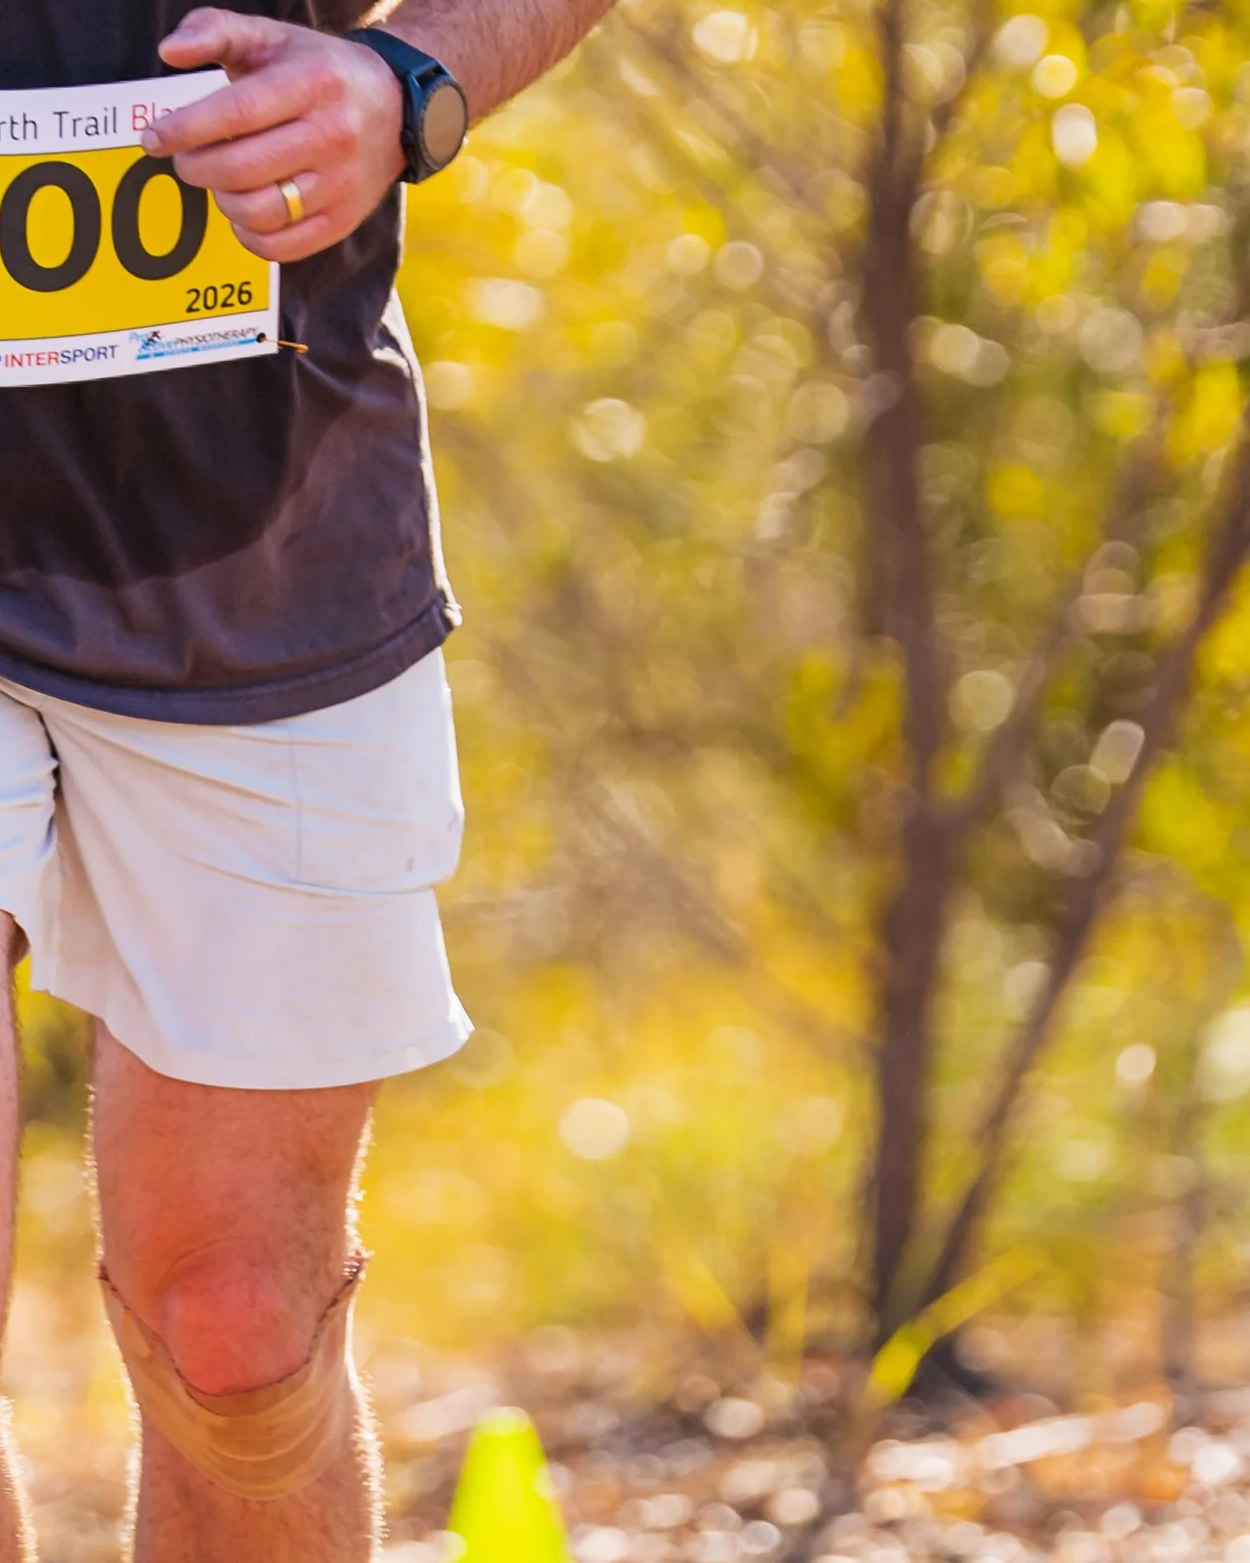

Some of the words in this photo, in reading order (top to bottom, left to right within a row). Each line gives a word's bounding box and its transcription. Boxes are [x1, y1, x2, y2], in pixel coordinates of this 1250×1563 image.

[53, 106, 118, 138] Trail
[185, 281, 253, 313] 2026
[4, 344, 119, 368] INTERSPORT
